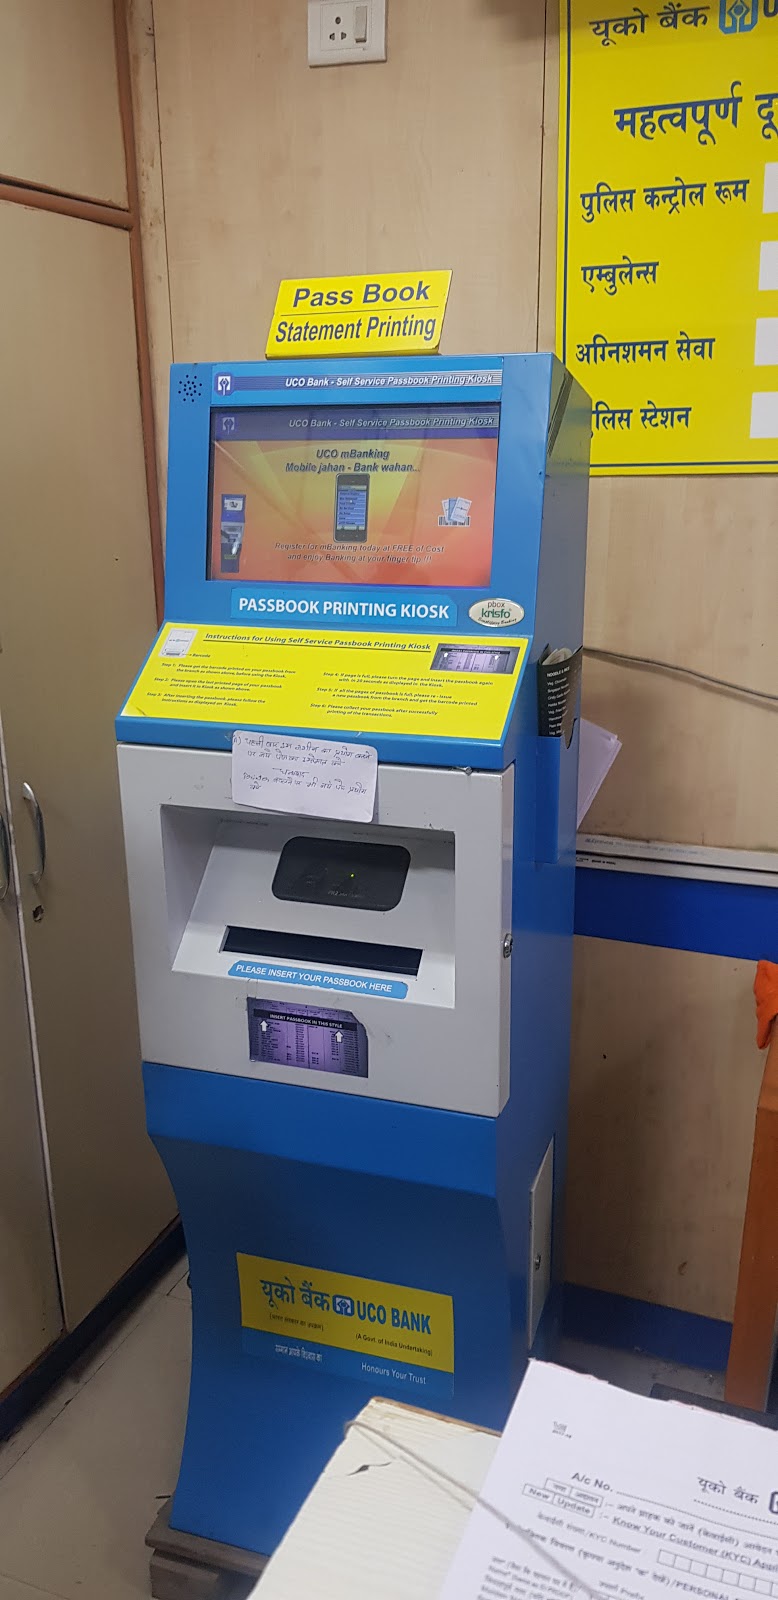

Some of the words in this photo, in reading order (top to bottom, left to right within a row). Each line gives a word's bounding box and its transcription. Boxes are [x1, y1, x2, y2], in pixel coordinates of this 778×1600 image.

[589, 8, 649, 46] यूको
[657, 3, 710, 29] बैंक
[614, 81, 743, 145] महत्वपूर्ण
[580, 182, 636, 223] पुलिस
[644, 177, 707, 214] कन्ट्रोल
[714, 180, 749, 204] रूम
[581, 256, 659, 296] एम्बुलेन्स
[292, 286, 353, 308] Pass
[362, 280, 430, 304] Book
[276, 317, 362, 342] Statement
[366, 314, 436, 340] Printing
[576, 334, 668, 365] अग्निशमन
[676, 331, 715, 360] सेवा
[285, 378, 305, 387] UCO
[307, 378, 329, 386] Bank
[336, 377, 353, 386] Self
[354, 377, 385, 386] Service
[388, 376, 430, 385] Passbook
[431, 376, 465, 385] Printing
[467, 374, 493, 384] Kiosk
[289, 419, 308, 428] UCO
[340, 419, 356, 427] Self
[357, 418, 386, 427] Service
[389, 418, 431, 427] Passbook
[432, 418, 466, 427] Printing
[468, 417, 494, 425] Kiosk
[592, 400, 632, 438] लिस
[640, 400, 692, 429] स्टेशन
[316, 449, 338, 459] UCO
[341, 449, 390, 460] mBanking
[286, 463, 317, 472] Mobile
[317, 463, 344, 474] jahan
[354, 463, 378, 472] Bank
[320, 544, 358, 552] mBanking
[360, 545, 380, 553] today
[240, 598, 320, 614] PASSBOOK
[323, 601, 396, 617] PRINTING
[401, 602, 449, 619] KIOSK
[482, 608, 510, 618] krisfo
[236, 965, 266, 975] PLEASE
[268, 968, 297, 979] INSERT
[299, 972, 322, 983] YOUR
[323, 976, 368, 989] PASSBOOK
[369, 982, 392, 992] HERE
[260, 1276, 295, 1309] यूको
[299, 1280, 330, 1311] बैंक
[357, 1300, 386, 1324] UCO
[391, 1307, 431, 1334] BANK
[363, 1334, 376, 1343] Govt.
[385, 1339, 397, 1347] India
[361, 1362, 389, 1376] Honours
[392, 1369, 407, 1380] Your
[409, 1373, 426, 1384] Trust
[529, 1488, 550, 1500] New
[572, 1472, 591, 1485] A/c
[594, 1479, 613, 1492] No.
[698, 1476, 727, 1495] यूको
[734, 1486, 759, 1504] बैंक
[557, 1498, 590, 1514] Update
[609, 1539, 641, 1552] Number
[612, 1516, 642, 1531] Know
[644, 1526, 667, 1539] Your
[669, 1534, 718, 1556] Customer
[720, 1549, 751, 1566] (KYC)
